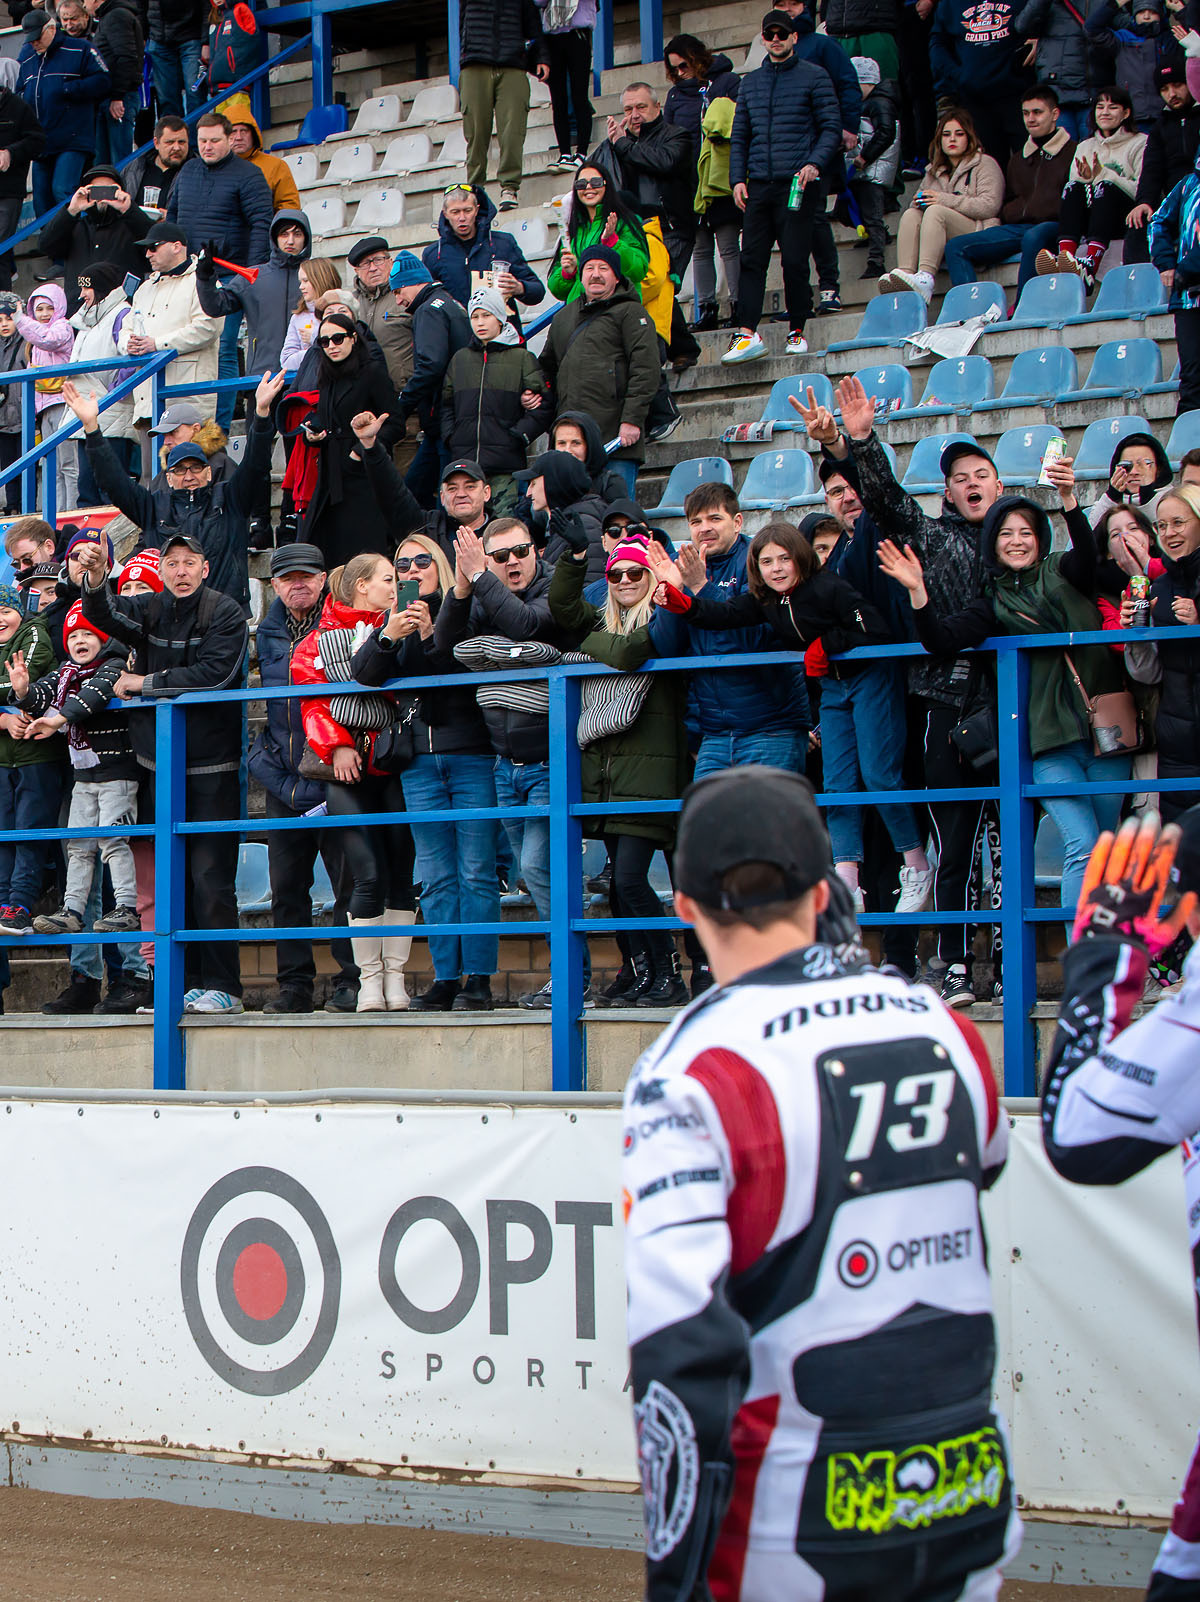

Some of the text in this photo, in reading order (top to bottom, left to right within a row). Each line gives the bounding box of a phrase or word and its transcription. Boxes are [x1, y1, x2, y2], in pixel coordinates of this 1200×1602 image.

[965, 27, 1010, 42] GRAND PRIX
[378, 99, 385, 107] 2
[353, 147, 360, 156] 3
[297, 156, 303, 165] 2
[381, 192, 387, 201] 5
[322, 200, 328, 209] 4
[521, 221, 528, 231] 6
[1128, 268, 1135, 281] 4
[1049, 278, 1057, 290] 3
[971, 287, 979, 299] 2
[893, 297, 898, 310] 1
[1039, 352, 1047, 363] 4
[1117, 345, 1127, 359] 5
[957, 361, 965, 374] 3
[877, 370, 886, 383] 2
[799, 379, 803, 392] 1
[1111, 420, 1119, 434] 6
[233, 440, 239, 451] 6
[1023, 432, 1032, 447] 5
[774, 454, 784, 469] 2
[698, 462, 703, 477] 1
[126, 556, 160, 568] OMOT
[845, 1069, 956, 1162] 13
[887, 1228, 973, 1272] OPTIBET
[378, 1195, 614, 1341] OPT
